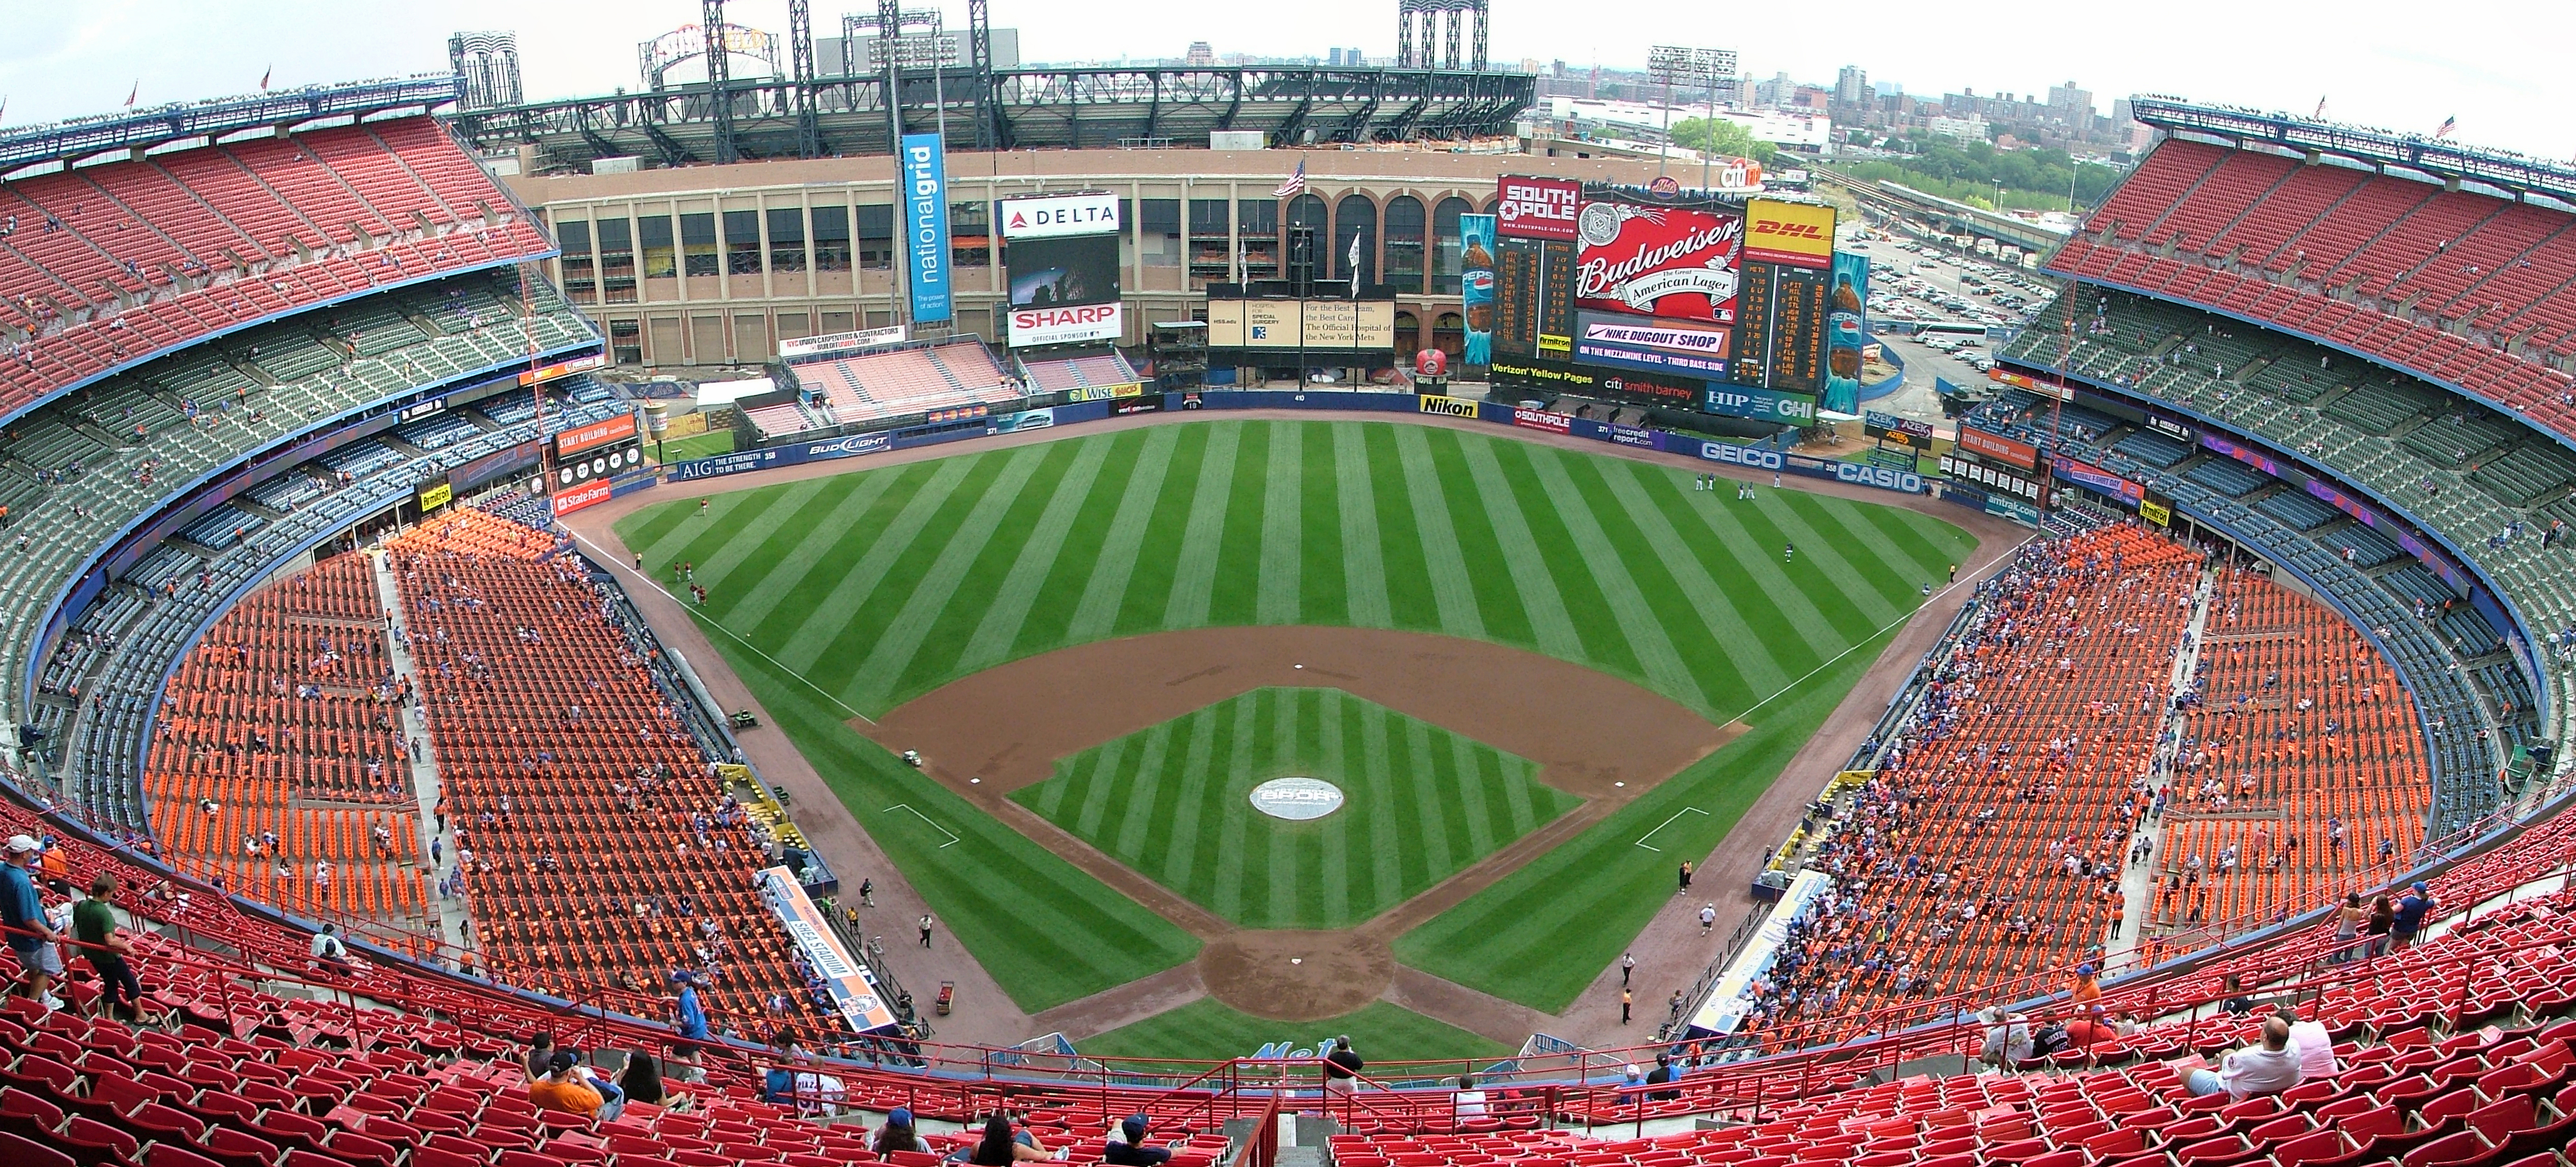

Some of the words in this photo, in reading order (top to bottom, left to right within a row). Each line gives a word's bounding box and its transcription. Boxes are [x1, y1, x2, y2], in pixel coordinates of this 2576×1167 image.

[1507, 185, 1576, 205] SOUTH
[908, 146, 938, 283] nationalgrid
[1037, 207, 1114, 224] DELTA
[1520, 202, 1575, 220] POLE
[1753, 220, 1823, 240] DHL
[1577, 217, 1743, 298] Budweiser
[1633, 279, 1689, 300] American
[1693, 275, 1730, 291] Lager
[1015, 306, 1114, 329] SHARP
[817, 334, 853, 344] CARPENTERS
[859, 328, 898, 338] CONTRACTORS
[1061, 332, 1087, 340] SPONSOR
[1540, 335, 1570, 346] Armitron
[1605, 328, 1627, 342] NIKE
[1629, 331, 1677, 346] DUGOUT
[1677, 335, 1717, 348] SHOP
[1579, 345, 1590, 354] ON
[1590, 346, 1603, 356] THE
[1604, 347, 1643, 361] MEZZANINE
[1643, 353, 1663, 364] LEVEL
[1667, 356, 1689, 367] THIRD
[1689, 359, 1707, 369] BASE
[1707, 361, 1724, 372] SIDE
[1416, 376, 1432, 385] HOME
[1531, 368, 1562, 380] Yellow
[1564, 371, 1593, 385] Pages
[1605, 376, 1622, 390] citi
[1625, 382, 1654, 393] smith
[1656, 385, 1692, 401] barney
[1424, 398, 1474, 416] Nikon
[1707, 391, 1748, 406] HIP
[1777, 399, 1812, 419] GHI
[1522, 413, 1570, 427] SOUTHPOLE
[1868, 413, 1893, 425] AZEK
[1901, 420, 1928, 433] AZEK
[560, 435, 579, 449] START
[580, 427, 608, 443] BUILDING
[1613, 426, 1649, 438] freecredit
[1613, 434, 1652, 446] report.com
[1886, 431, 1907, 442] AZEK
[809, 445, 841, 455] BUD
[849, 437, 888, 450] LIGHT
[1964, 433, 1981, 446] START
[1982, 439, 2009, 455] BUILDING
[728, 453, 761, 464] STRENGTH
[765, 452, 776, 460] 358
[1702, 443, 1781, 469] GEICO
[683, 461, 712, 478] AIG
[1838, 464, 1922, 490] CASIO
[423, 490, 449, 505] Armitron
[1988, 495, 2037, 518] amtrak.com
[2143, 503, 2168, 524] Armitron
[795, 922, 818, 942] SHEA
[810, 942, 848, 975] STADIUM
